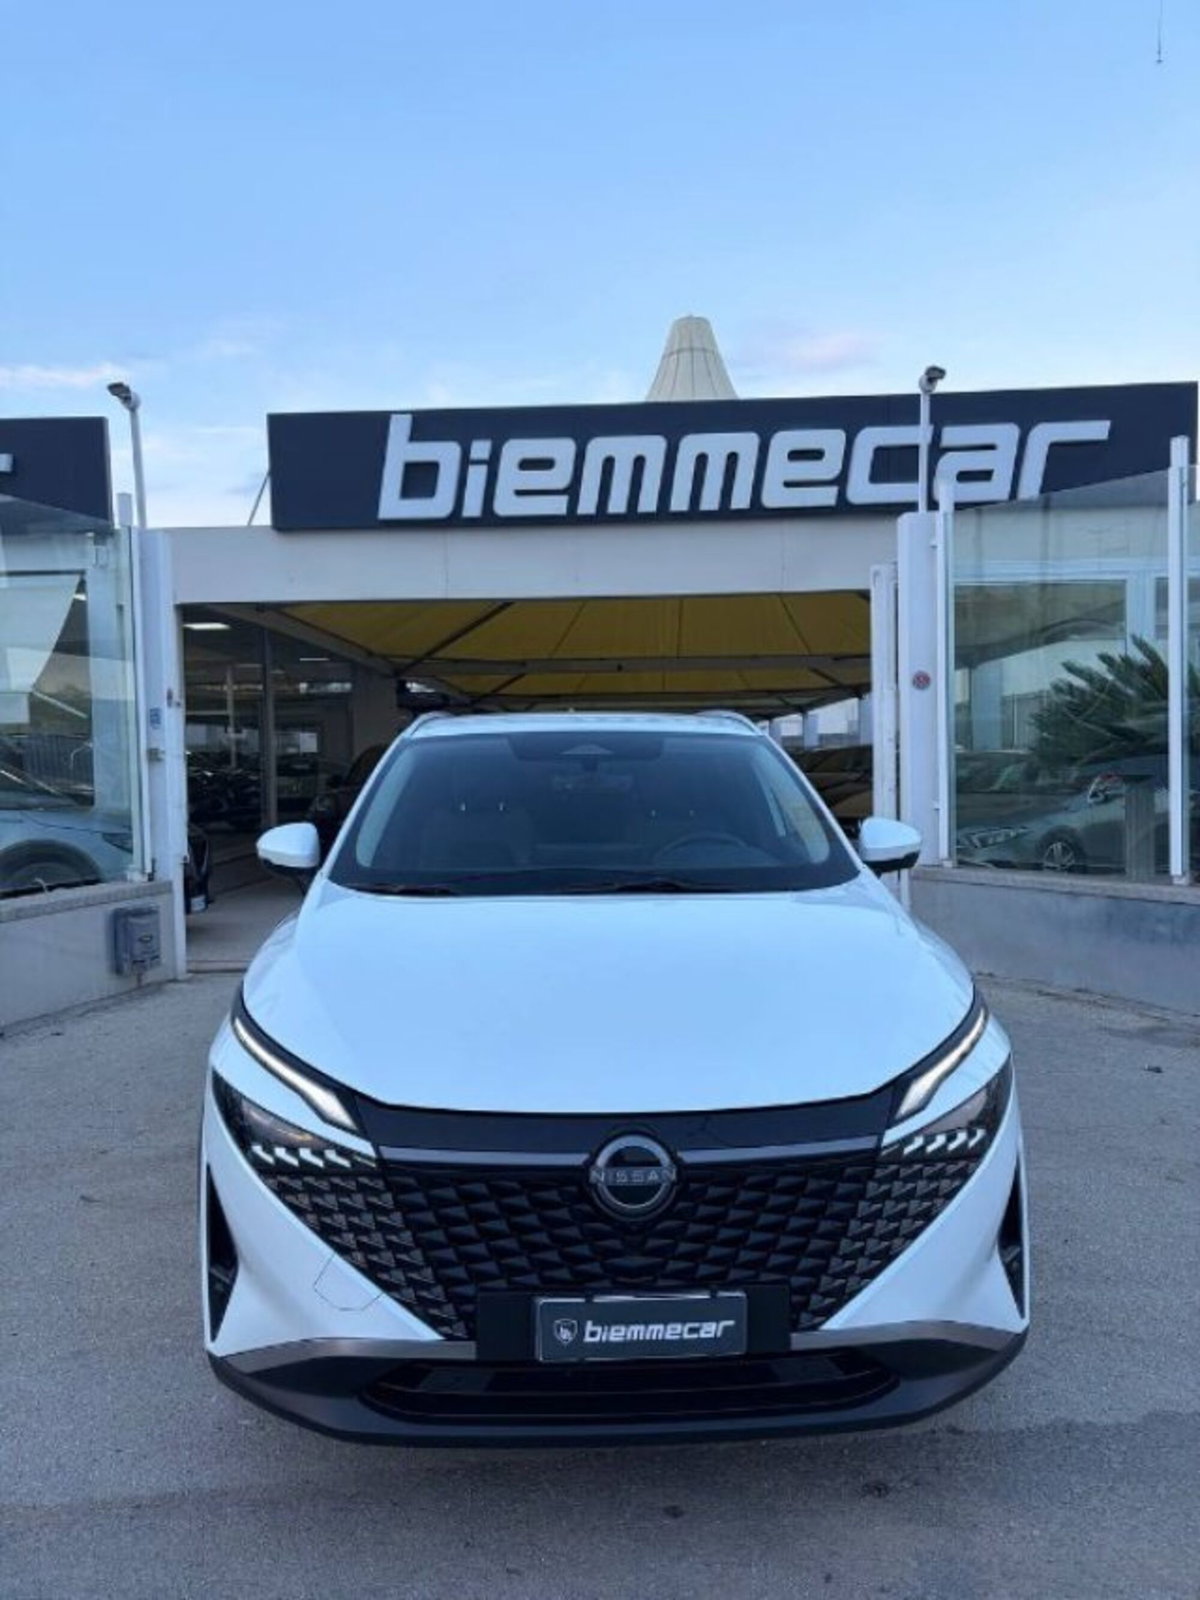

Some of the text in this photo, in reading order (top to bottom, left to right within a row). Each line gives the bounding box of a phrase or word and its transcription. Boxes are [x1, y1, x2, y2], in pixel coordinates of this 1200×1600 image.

[378, 414, 1111, 519] biemmecar
[589, 1167, 677, 1184] NISSAN
[584, 1320, 735, 1343] biemmecar
